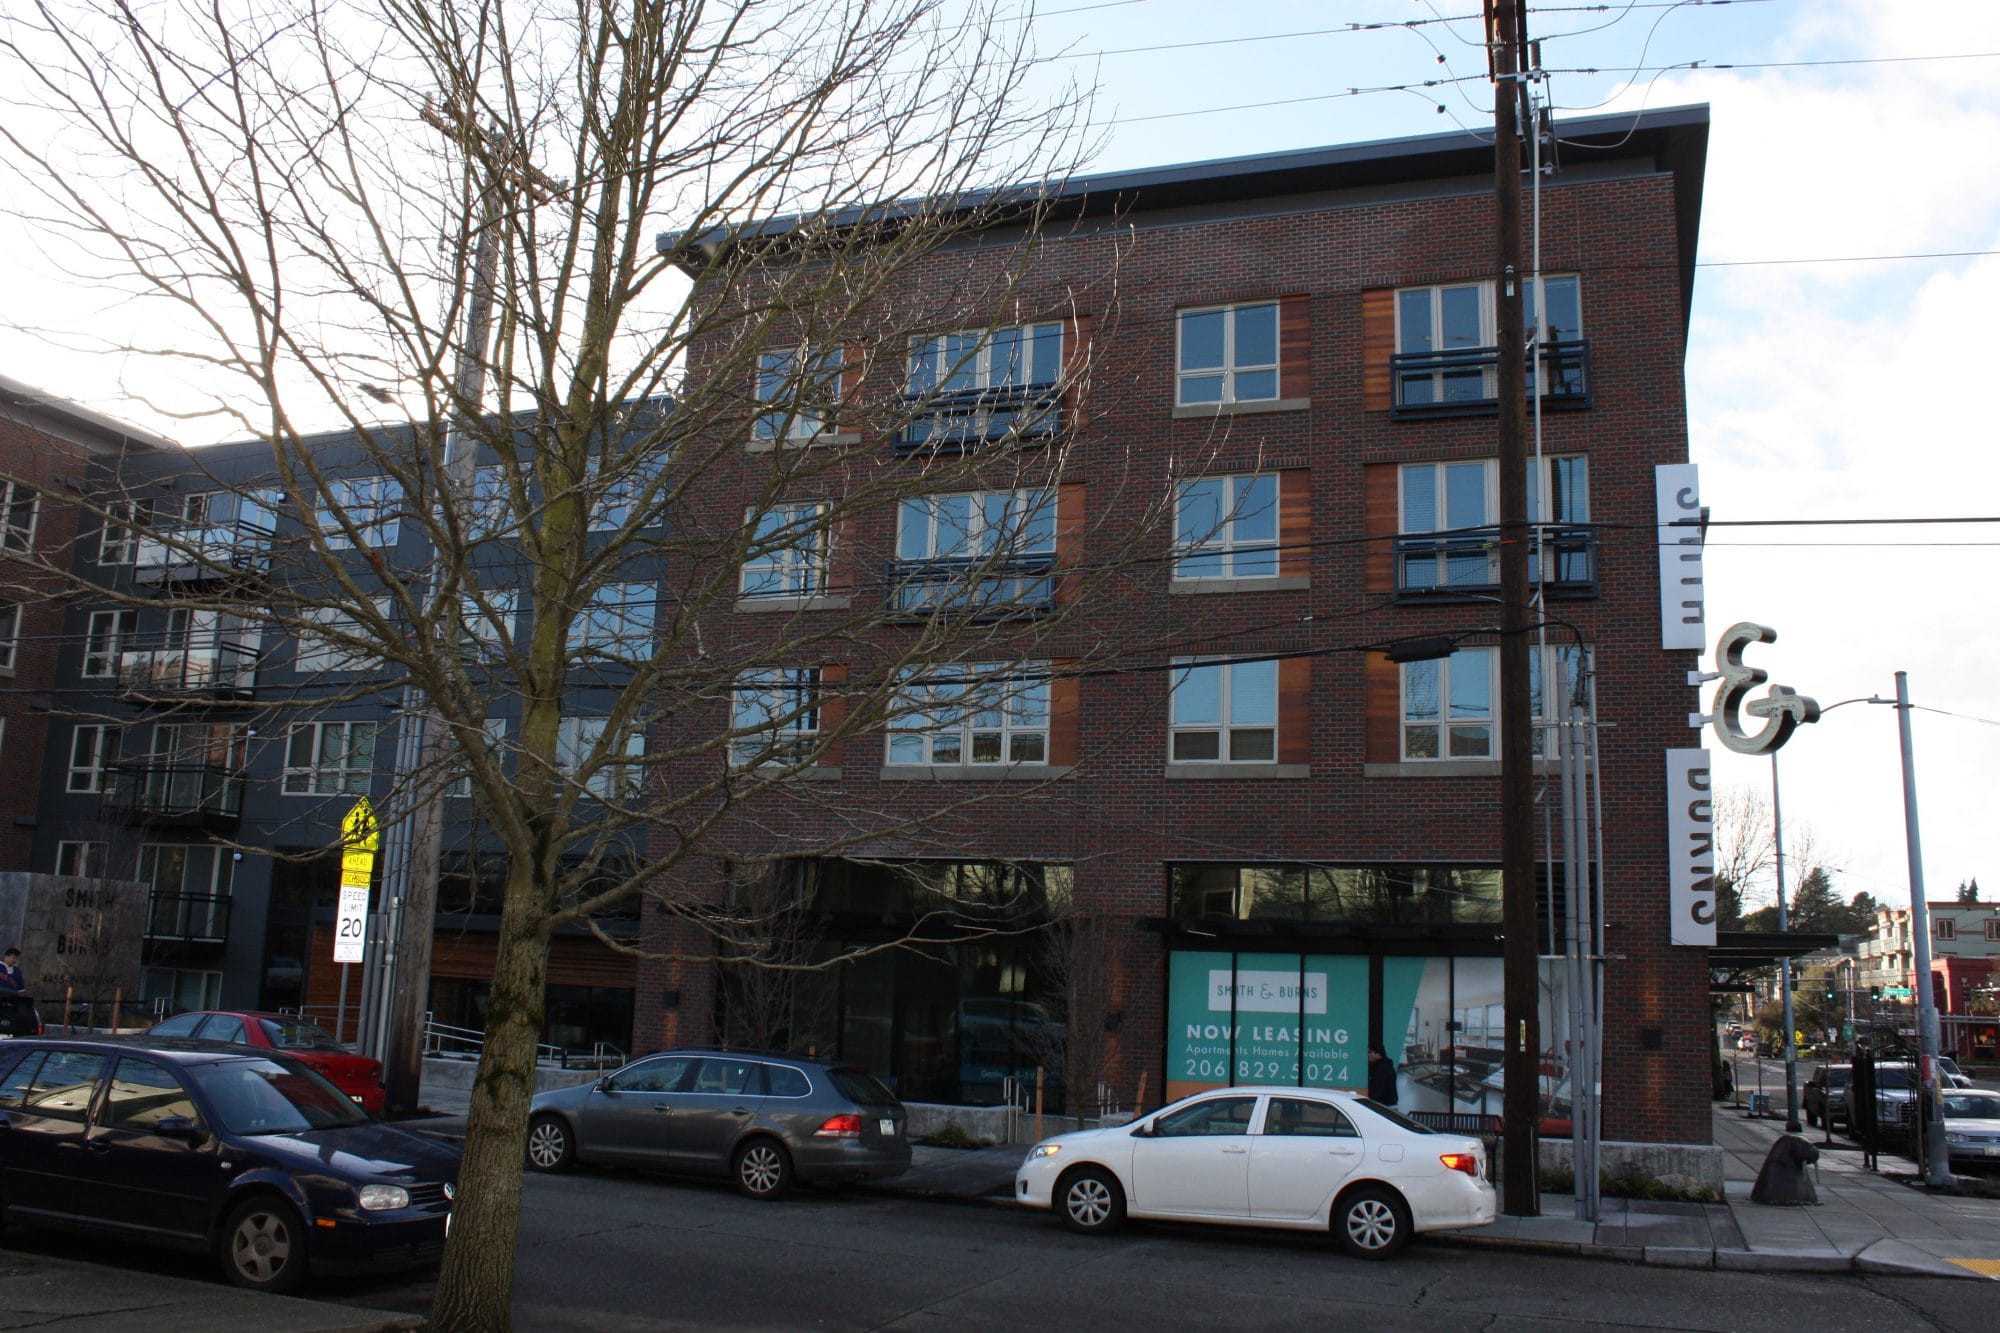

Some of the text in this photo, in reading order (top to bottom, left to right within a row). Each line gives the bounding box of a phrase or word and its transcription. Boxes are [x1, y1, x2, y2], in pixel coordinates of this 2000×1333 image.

[1712, 622, 1820, 755] &
[348, 856, 368, 866] AHEAD
[344, 873, 369, 884] SCHOOL
[65, 887, 114, 909] SMITH
[343, 890, 367, 901] SPEED
[343, 903, 364, 913] LIMIT
[340, 917, 362, 938] 20
[1217, 983, 1317, 1000] SMITH & BURNS
[1187, 1024, 1349, 1044] NOW LEASING
[1253, 1046, 1289, 1057] Homes
[1186, 1059, 1225, 1077] 206
